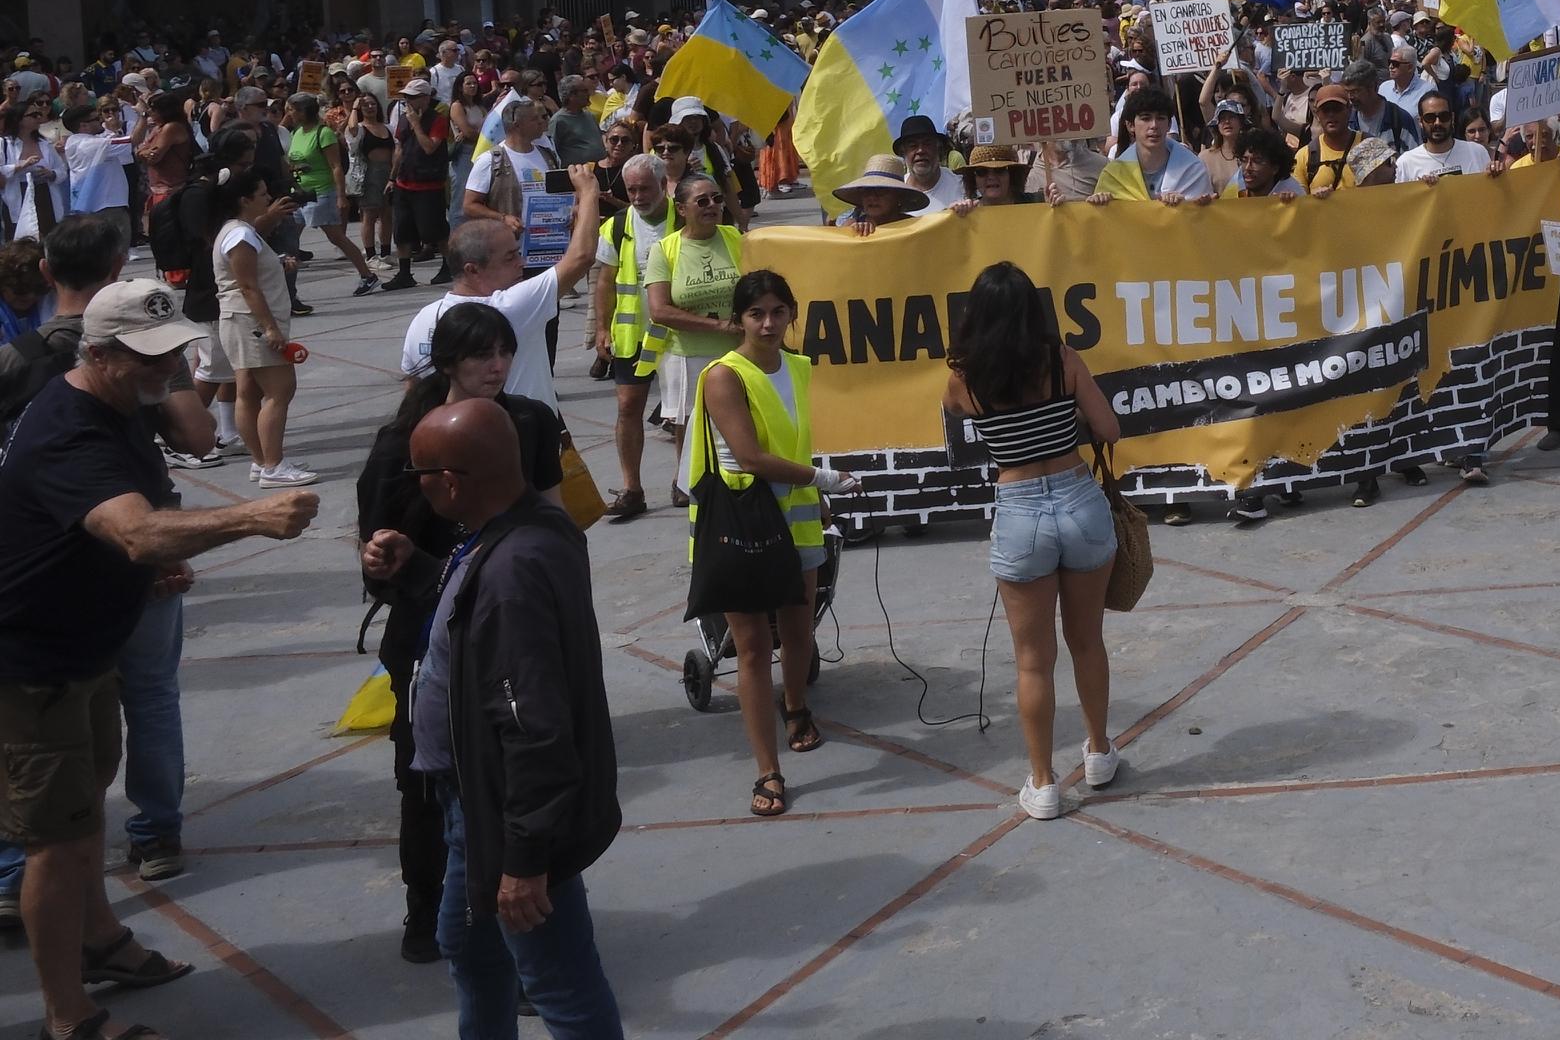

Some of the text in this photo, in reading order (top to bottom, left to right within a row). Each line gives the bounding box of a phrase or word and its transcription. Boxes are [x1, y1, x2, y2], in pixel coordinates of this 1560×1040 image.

[1154, 2, 1212, 22] EN CANARIAS
[979, 13, 1091, 52] Buitres
[1165, 13, 1230, 35] LOS ALQUILERES
[1274, 24, 1344, 41] CANARIAS NO
[1207, 31, 1230, 47] ALTOS
[1277, 39, 1290, 52] SE
[1329, 35, 1344, 48] SE
[988, 45, 1096, 70] carroñeros
[1166, 53, 1186, 68] QUE
[1186, 52, 1196, 65] EL
[1285, 47, 1347, 69] DEFIENDE
[1016, 65, 1073, 86] FUERA
[990, 83, 1092, 111] DE NUESTRO
[1516, 97, 1528, 111] en
[1532, 87, 1542, 108] la
[1008, 103, 1095, 138] PUEBLO
[1116, 274, 1297, 346] TIENE
[1319, 262, 1405, 335] UN
[1416, 232, 1547, 314] LÍMITE
[1112, 330, 1421, 416] CAMBIO DE MODELO!
